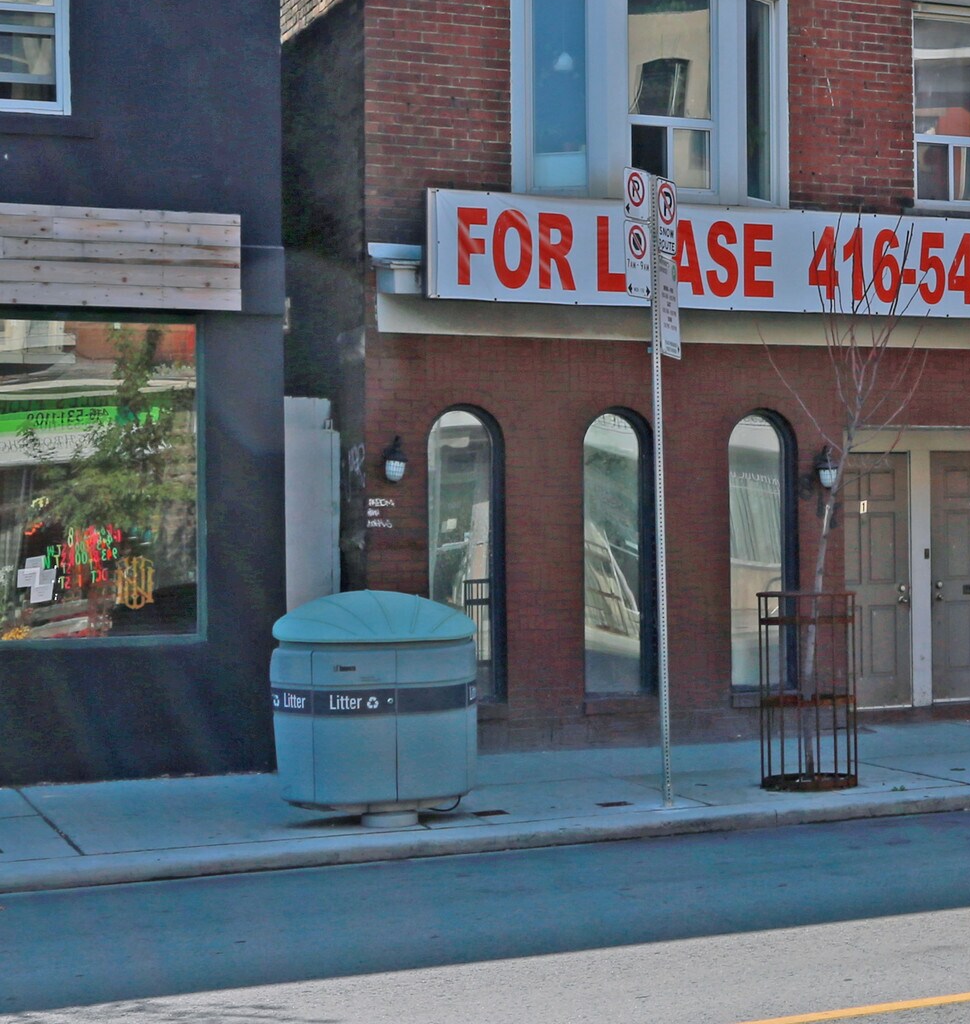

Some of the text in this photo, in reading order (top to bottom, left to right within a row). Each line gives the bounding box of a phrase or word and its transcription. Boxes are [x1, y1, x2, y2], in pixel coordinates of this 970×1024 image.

[659, 226, 675, 239] SNOW
[457, 207, 576, 291] FOR
[597, 215, 774, 298] LASE
[283, 693, 306, 709] Litter
[329, 695, 362, 710] Litter
